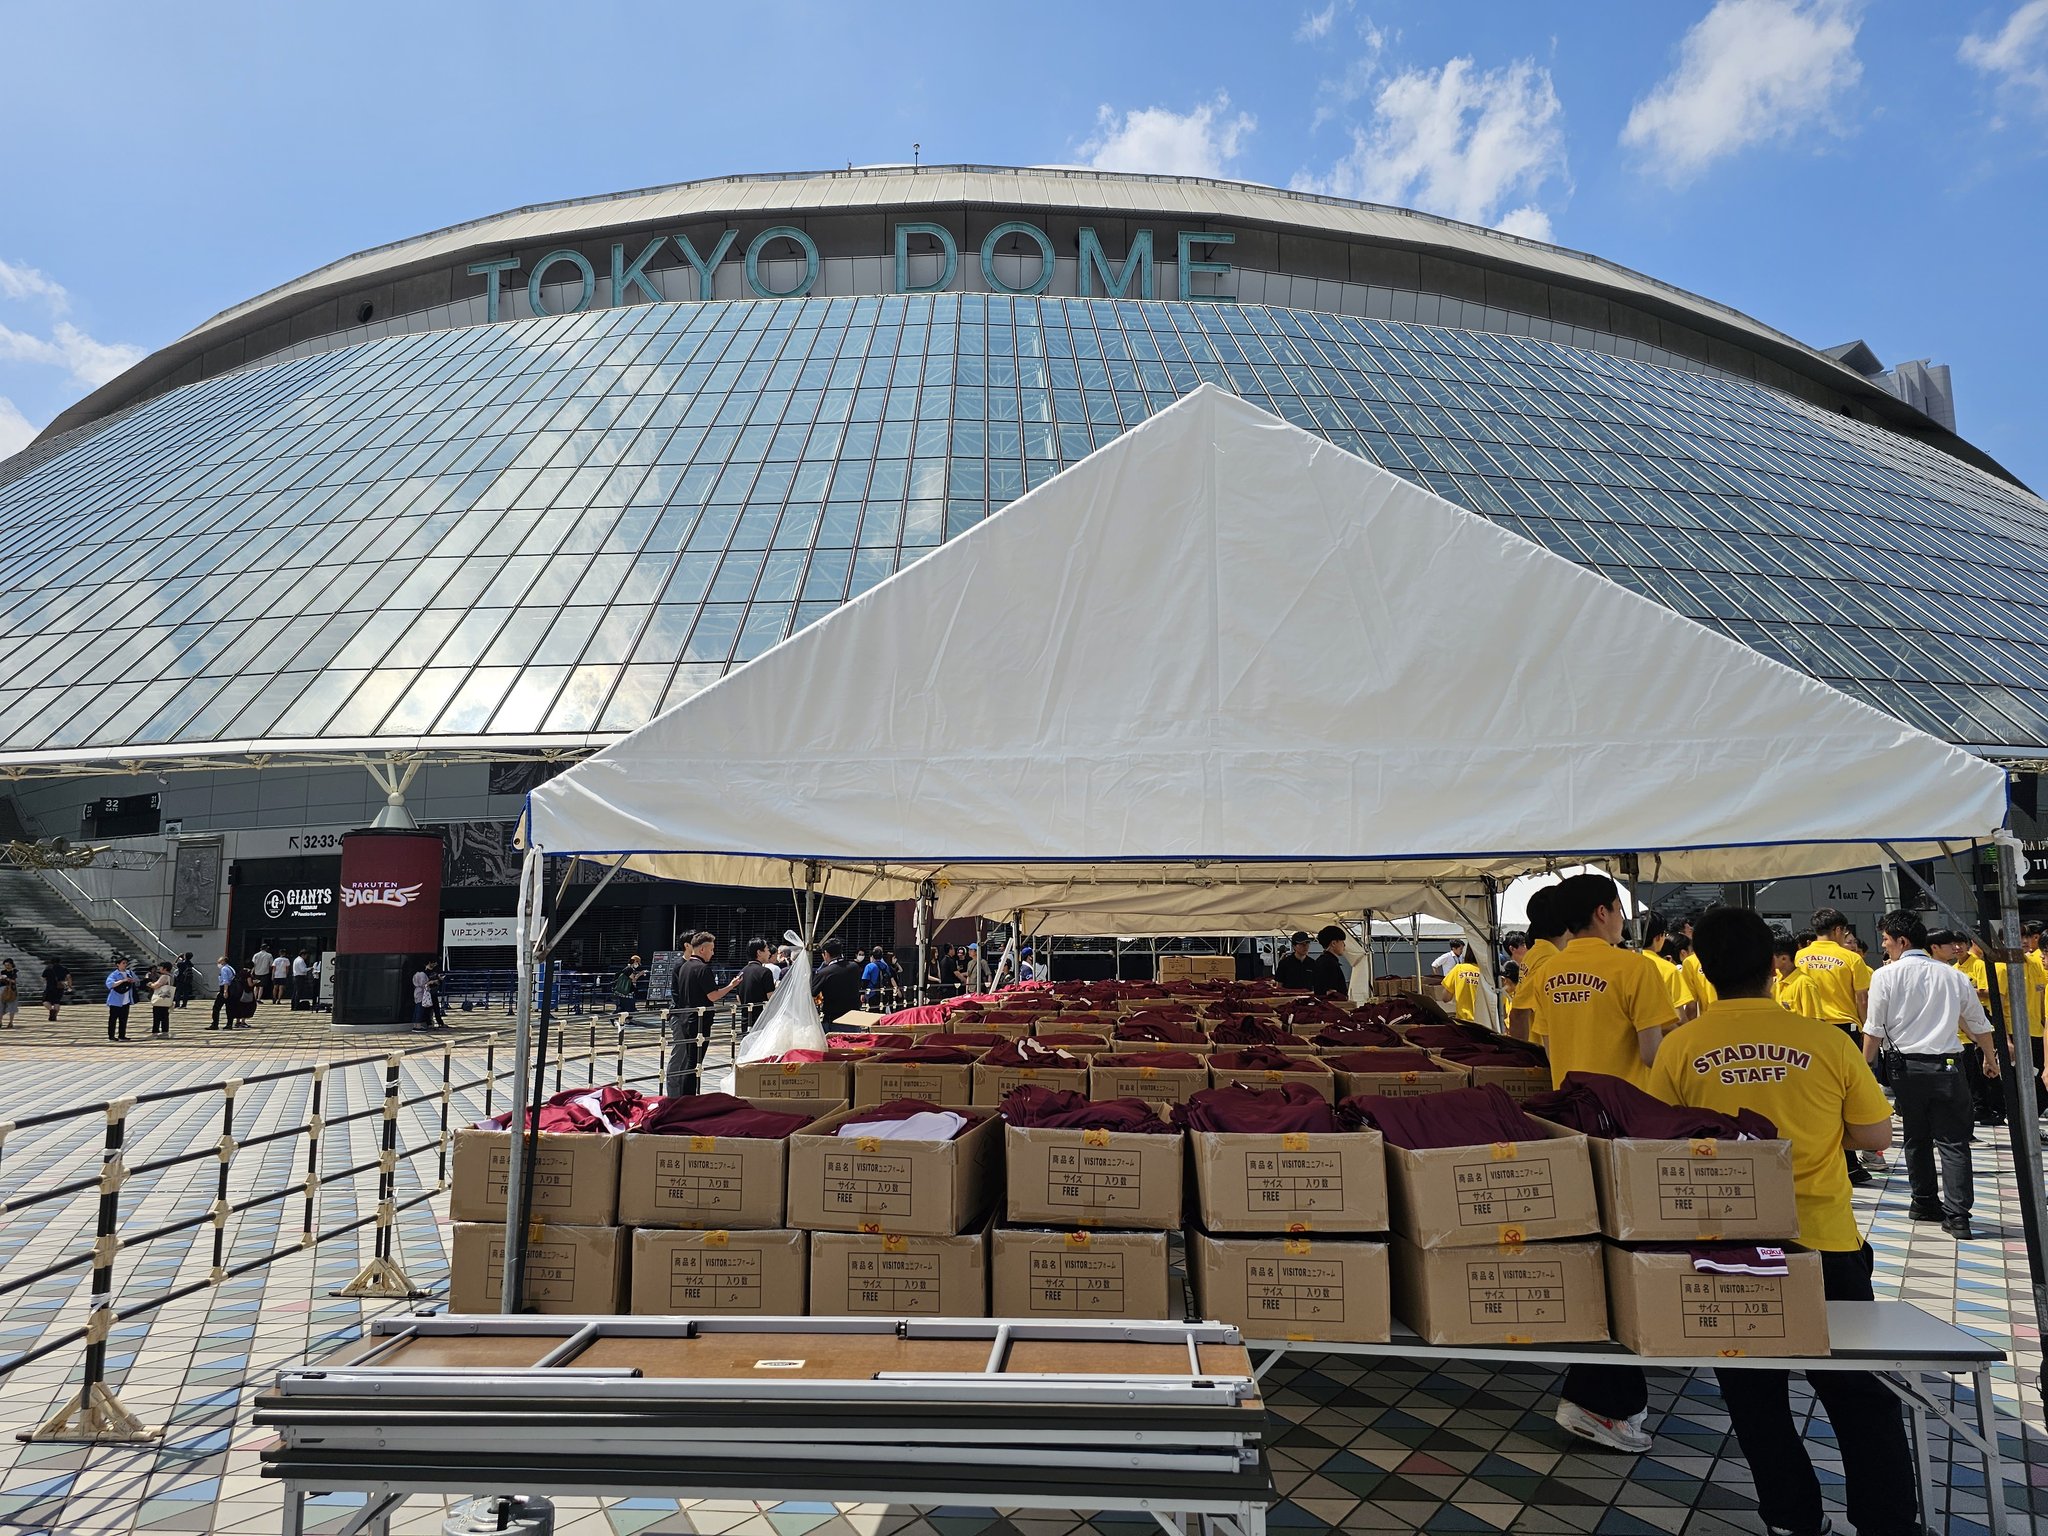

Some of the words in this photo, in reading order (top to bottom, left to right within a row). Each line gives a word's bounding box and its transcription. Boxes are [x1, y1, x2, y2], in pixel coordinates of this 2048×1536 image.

[467, 225, 820, 323] TOKYO
[895, 221, 1236, 303] DOME
[287, 888, 332, 905] GIANTS
[1828, 884, 1842, 900] 21
[343, 888, 409, 908] EAGLES
[452, 928, 508, 936] VIPエントランス
[1798, 955, 1845, 966] STADIUM
[1545, 972, 1608, 995] STADIUM
[1553, 990, 1591, 1004] STAFF
[1693, 1043, 1811, 1074] STADIUM
[1720, 1066, 1787, 1085] STAFF
[659, 1159, 680, 1168] 商品名
[1052, 1155, 1075, 1165] 商品名
[1250, 1160, 1273, 1170] 商品名
[828, 1162, 848, 1171] 商品名
[1661, 1166, 1685, 1176] 商品名
[1063, 1174, 1082, 1183] サイズ
[1105, 1176, 1126, 1185] 入り数
[1458, 1172, 1483, 1183] 商品名
[670, 1178, 686, 1186] サイズ
[709, 1179, 729, 1188] 入り数
[838, 1181, 855, 1190] サイズ
[878, 1183, 898, 1192] 入り数
[1263, 1178, 1282, 1188] サイズ
[1306, 1178, 1328, 1188] 入り数
[669, 1189, 683, 1198] FREE
[1062, 1186, 1078, 1196] FREE
[1263, 1191, 1279, 1201] FREE
[1473, 1191, 1493, 1200] サイズ
[1516, 1187, 1539, 1197] 入り数
[1674, 1186, 1695, 1195] サイズ
[1718, 1186, 1741, 1196] 入り数
[837, 1193, 852, 1202] FREE
[1473, 1204, 1491, 1215] FREE
[1675, 1200, 1693, 1209] FREE
[492, 1250, 505, 1258] 商品
[675, 1257, 696, 1267] 商品名
[852, 1261, 874, 1270] 商品名
[1033, 1260, 1056, 1269] 商品名
[1251, 1267, 1274, 1277] 商品名
[1471, 1271, 1495, 1280] 商品名
[686, 1277, 703, 1285] サイズ
[727, 1276, 748, 1285] 入り数
[863, 1280, 881, 1288] サイズ
[905, 1280, 926, 1289] 入り数
[1045, 1279, 1064, 1287] サイズ
[1088, 1279, 1109, 1288] 入り数
[685, 1289, 700, 1298] FREE
[1263, 1287, 1283, 1296] サイズ
[1307, 1287, 1330, 1297] 入り数
[1685, 1283, 1710, 1294] 商品名
[862, 1292, 878, 1301] FREE
[1045, 1291, 1061, 1300] FREE
[1485, 1290, 1504, 1299] サイズ
[1528, 1289, 1550, 1299] 入り数
[1263, 1299, 1279, 1310] FREE
[1485, 1303, 1502, 1313] FREE
[1699, 1303, 1720, 1313] サイズ
[1745, 1303, 1768, 1313] 入り数
[1699, 1317, 1717, 1327] FREE
